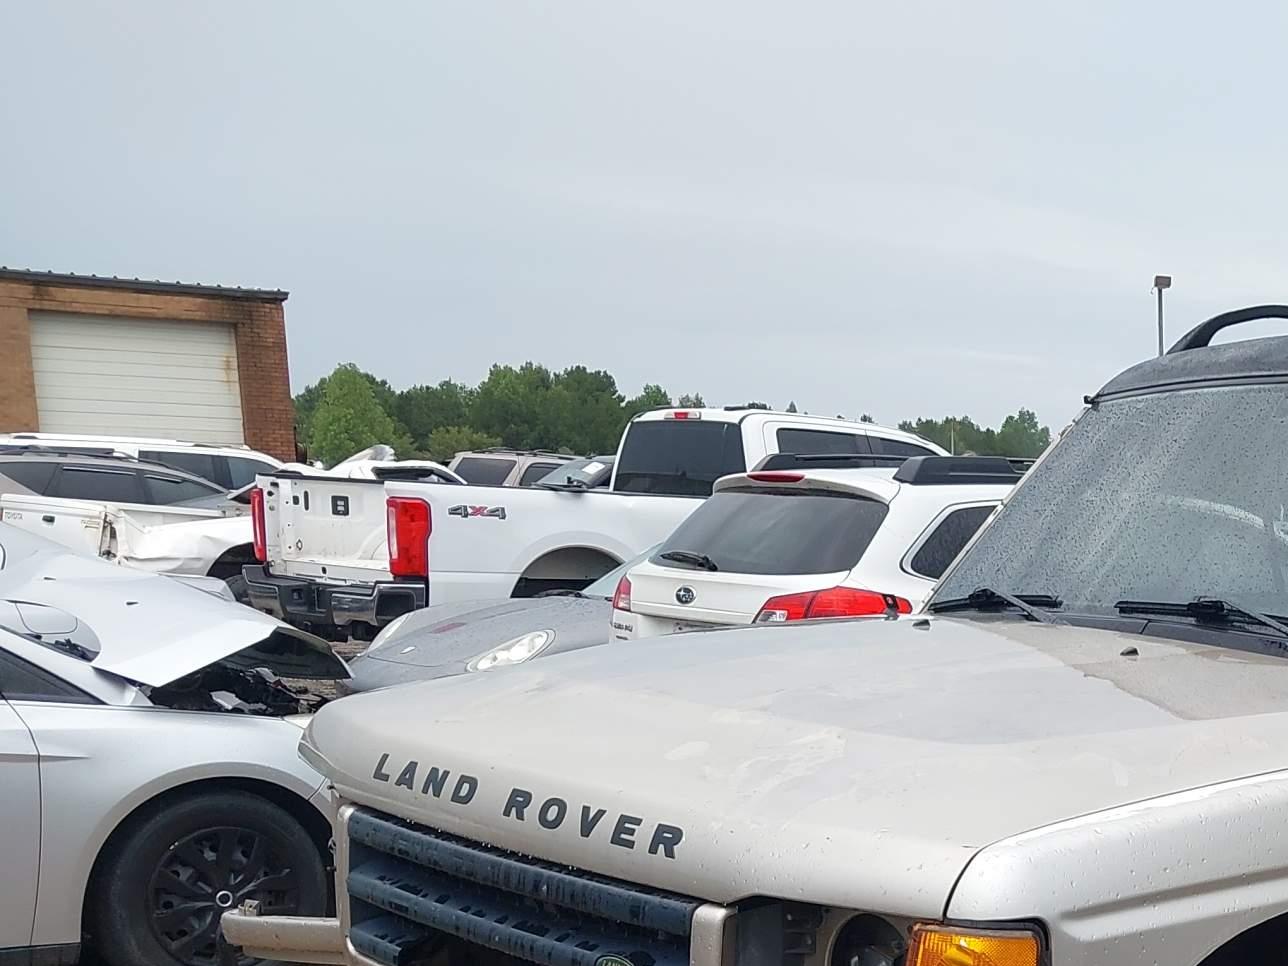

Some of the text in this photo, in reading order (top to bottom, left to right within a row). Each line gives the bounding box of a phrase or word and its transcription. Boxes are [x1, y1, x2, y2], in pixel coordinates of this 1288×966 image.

[447, 504, 507, 520] 4x4
[373, 753, 684, 859] LAND ROVER
